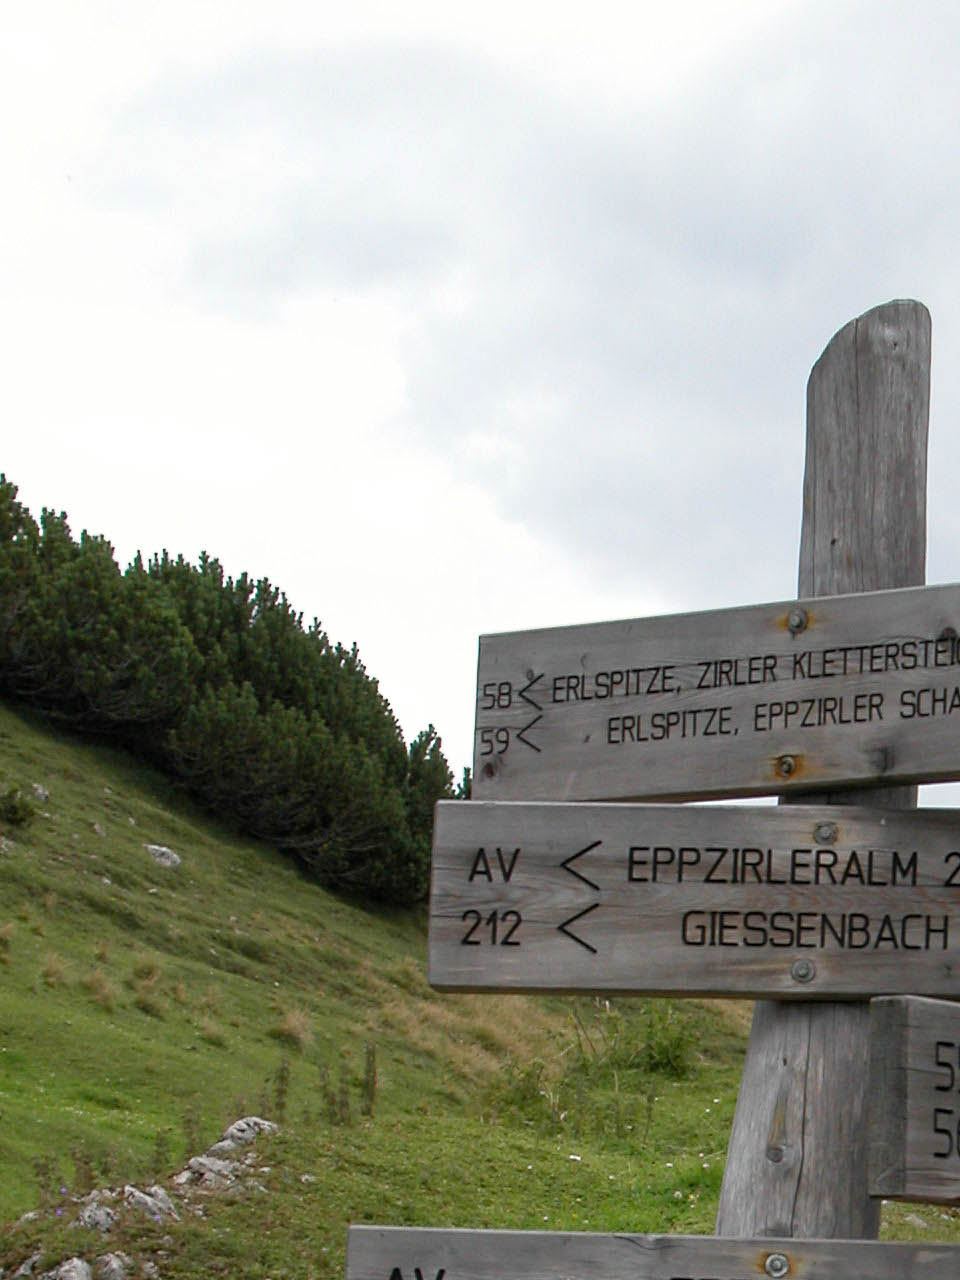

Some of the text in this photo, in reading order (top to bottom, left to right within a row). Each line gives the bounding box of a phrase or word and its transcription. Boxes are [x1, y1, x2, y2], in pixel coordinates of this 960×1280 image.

[481, 681, 513, 710] 58
[552, 665, 682, 704] ERLSPITZE,
[697, 655, 778, 690] ZIRLER
[480, 728, 510, 756] 59
[607, 706, 739, 744] ERLSPITZE,
[754, 692, 884, 732] EPPZIRLER
[468, 847, 521, 884] AV
[627, 847, 918, 887] EPPZIRLERALM
[460, 909, 523, 946] 212
[681, 910, 949, 951] GIESSENBACH
